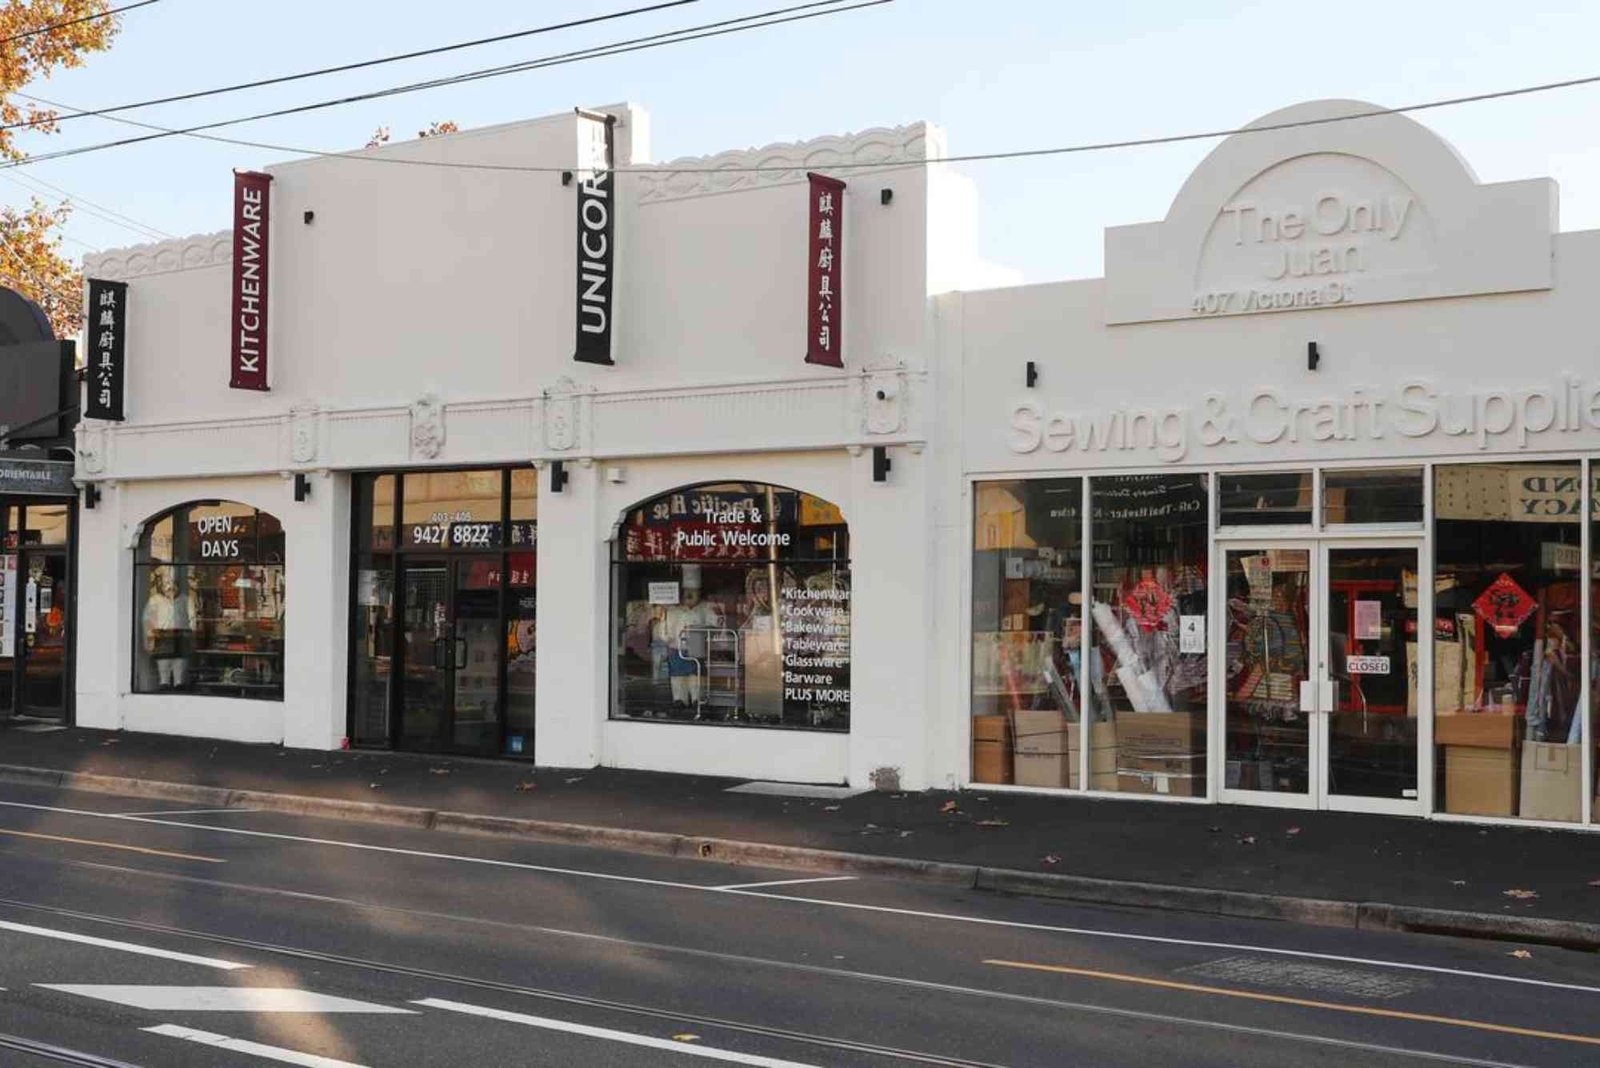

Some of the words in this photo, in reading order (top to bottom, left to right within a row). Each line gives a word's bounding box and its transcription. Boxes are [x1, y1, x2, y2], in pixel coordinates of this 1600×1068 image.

[1312, 190, 1413, 242] Only
[582, 126, 608, 334] UNICOR
[1264, 242, 1366, 281] Juan
[240, 187, 261, 372] KITCHENWARE
[1192, 291, 1236, 314] 407
[1008, 400, 1189, 463] Sewing
[1200, 391, 1239, 447] &
[1247, 383, 1384, 445] Craft
[704, 508, 745, 524] Trade
[751, 507, 762, 524] &
[198, 515, 232, 534] OPEN
[413, 526, 448, 544] 9427
[453, 524, 489, 543] 8822
[677, 530, 717, 547] Public
[723, 530, 790, 547] Welcome
[202, 540, 239, 557] DAYS
[786, 604, 844, 617] Cookware
[785, 620, 843, 633] Bakeware
[787, 637, 845, 652] Tableware
[785, 654, 843, 668] Glassware
[1342, 661, 1389, 673] CLOSED
[785, 670, 833, 685] Barware
[784, 687, 812, 700] PLUS
[815, 689, 850, 703] MORE
